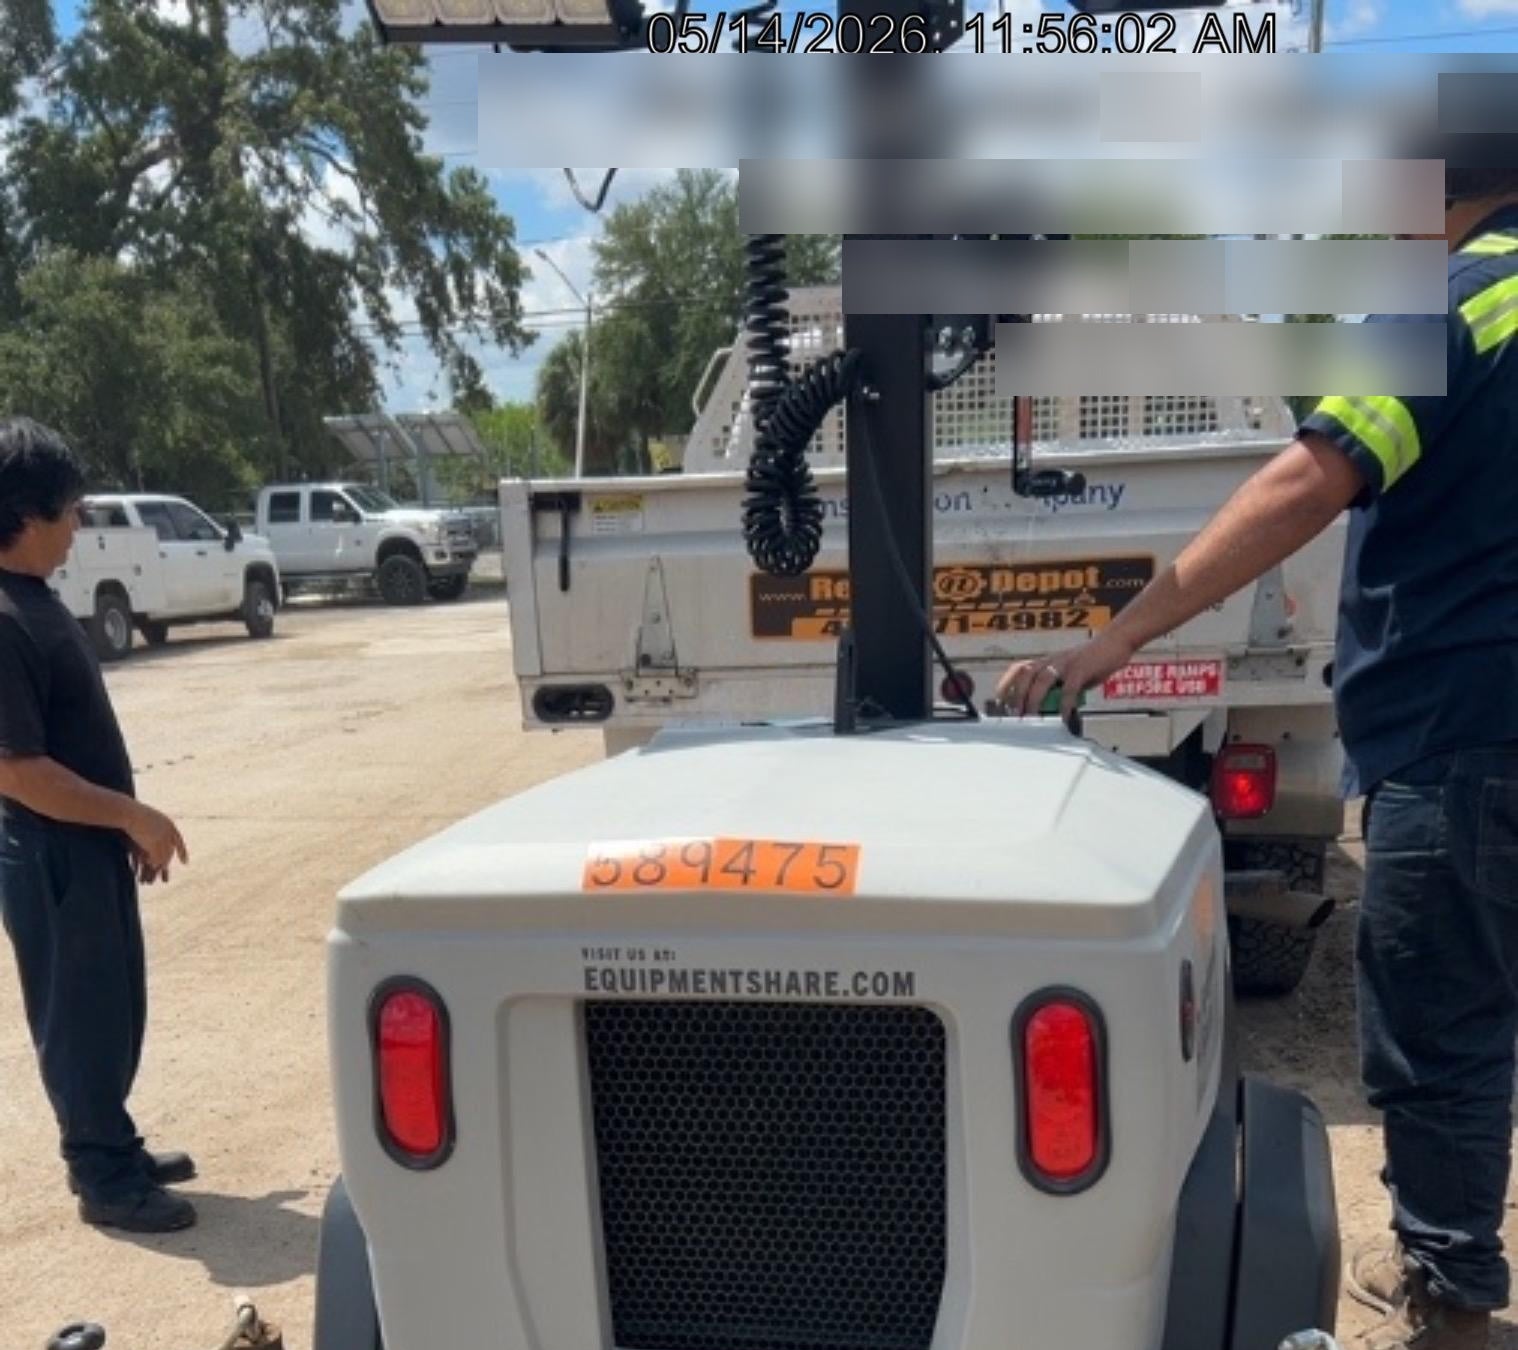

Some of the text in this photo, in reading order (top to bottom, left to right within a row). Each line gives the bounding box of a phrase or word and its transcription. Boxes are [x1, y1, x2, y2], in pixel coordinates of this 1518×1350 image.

[990, 566, 1099, 595] Depot
[591, 840, 849, 889] 589475
[584, 967, 916, 997] EQUIPMENTSHARE.COM
